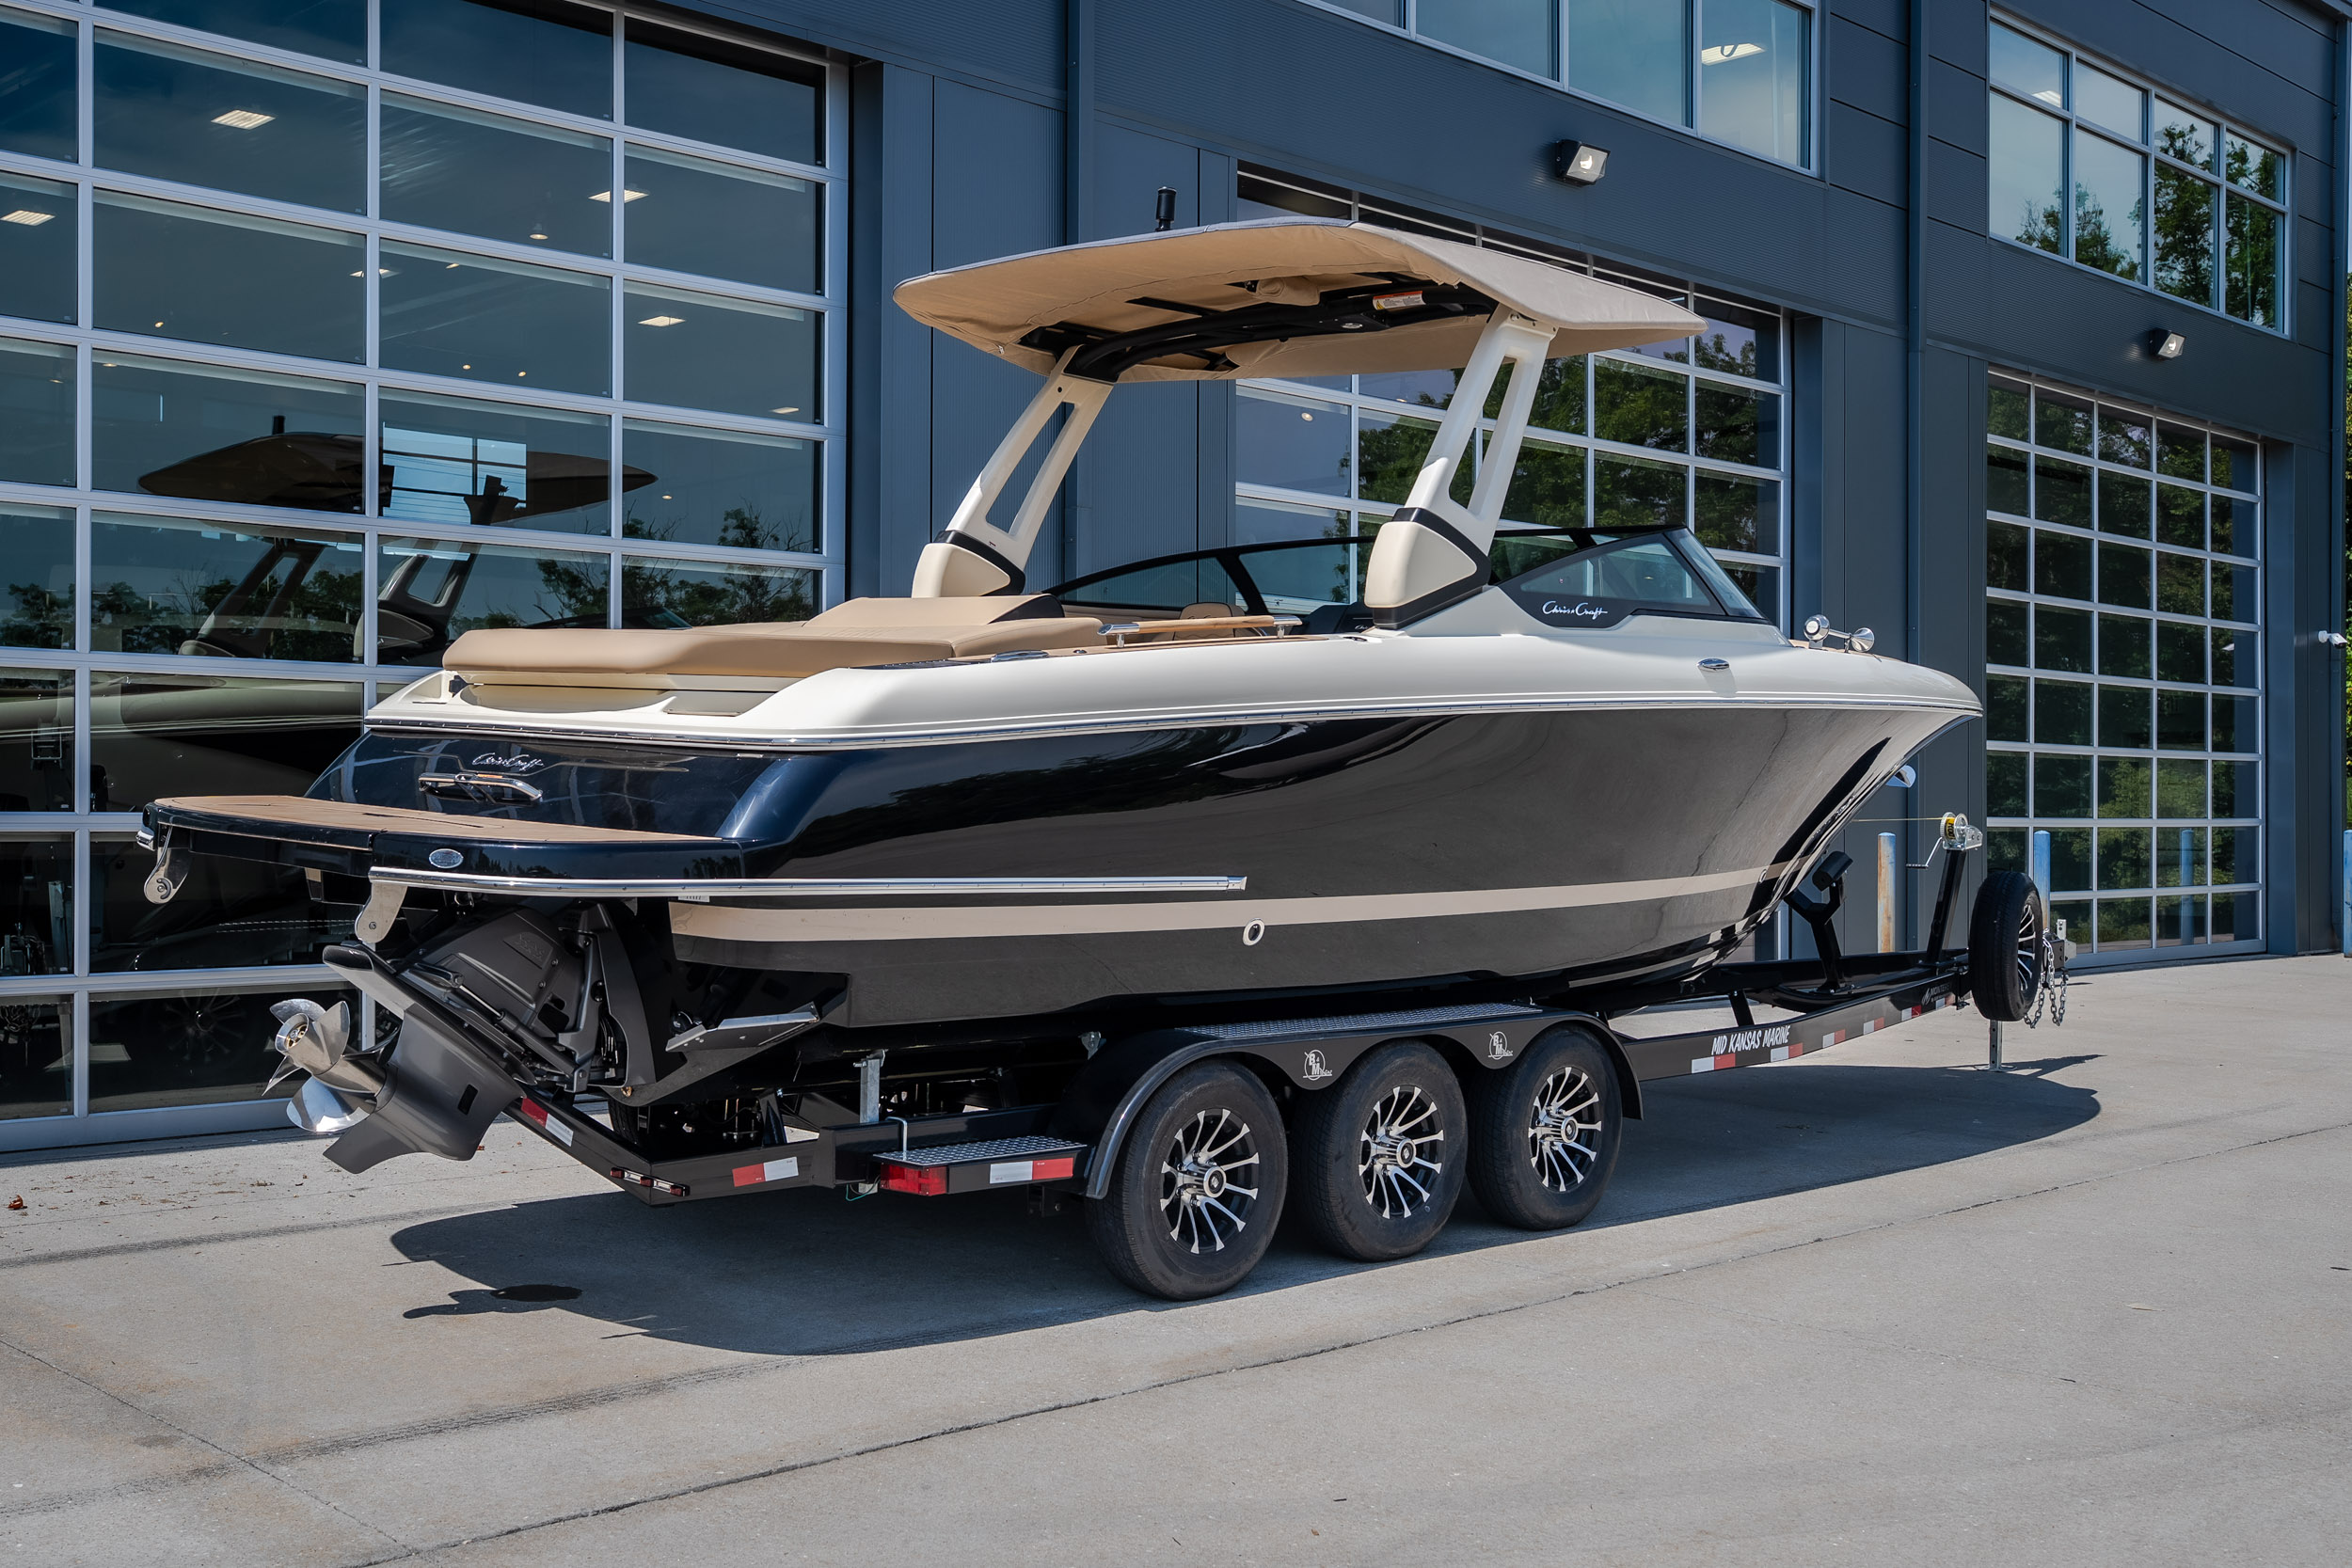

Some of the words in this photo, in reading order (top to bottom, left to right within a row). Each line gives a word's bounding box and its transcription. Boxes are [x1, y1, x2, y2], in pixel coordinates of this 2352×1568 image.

[1711, 1035, 1727, 1055] MID
[1728, 1030, 1762, 1053] KANSAS
[1762, 1024, 1791, 1048] MARINE
